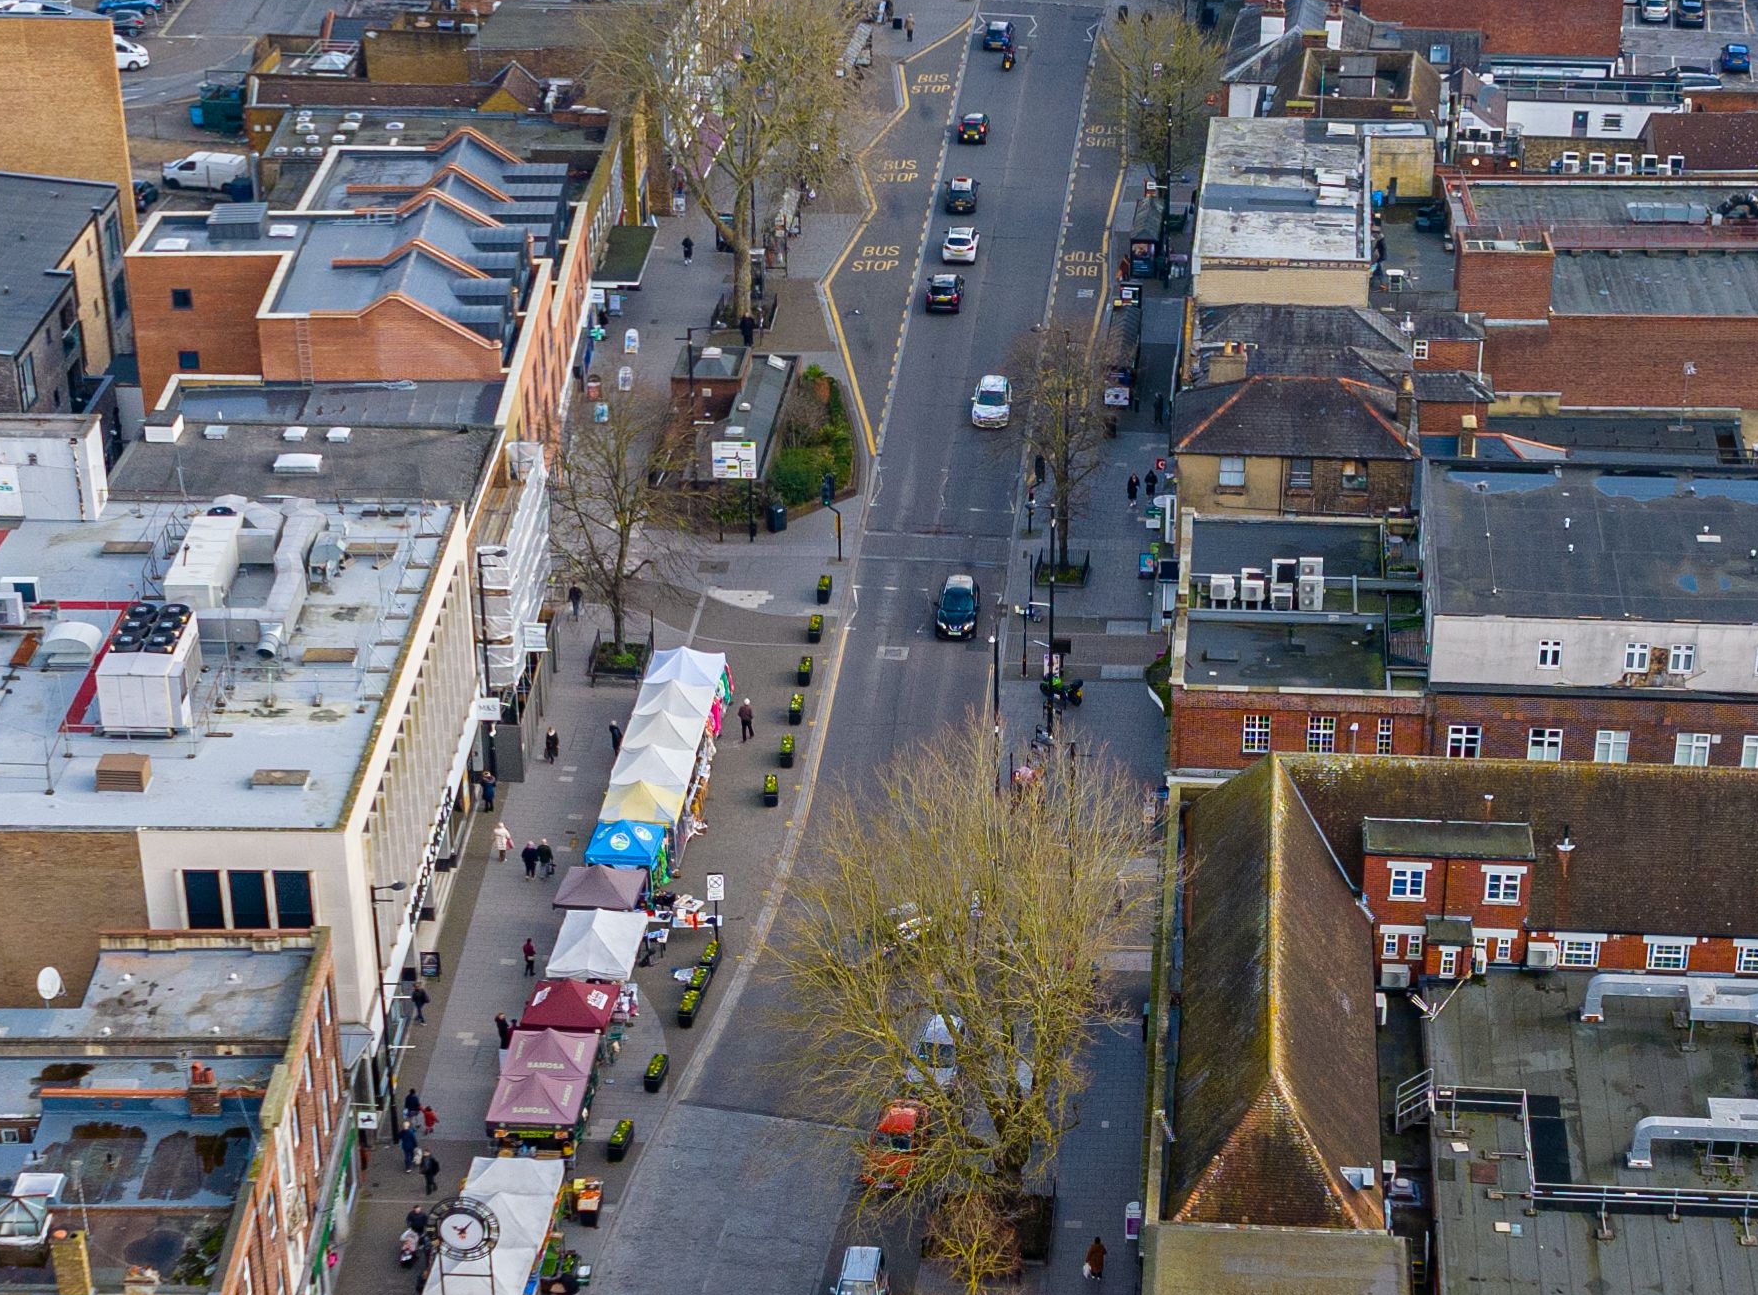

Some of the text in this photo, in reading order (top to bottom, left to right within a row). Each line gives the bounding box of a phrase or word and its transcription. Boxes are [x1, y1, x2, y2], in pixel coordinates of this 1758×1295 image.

[917, 73, 949, 84] BUS
[911, 84, 951, 95] STOP
[883, 159, 917, 170] BUS
[876, 172, 919, 183] STOP
[862, 245, 900, 257] BUS
[1064, 252, 1107, 263] STOP
[851, 260, 900, 272] STOP
[1065, 265, 1098, 277] BUS
[478, 704, 497, 712] M&S
[526, 1062, 565, 1070] SAMOSA
[511, 1106, 551, 1114] SAMOSA
